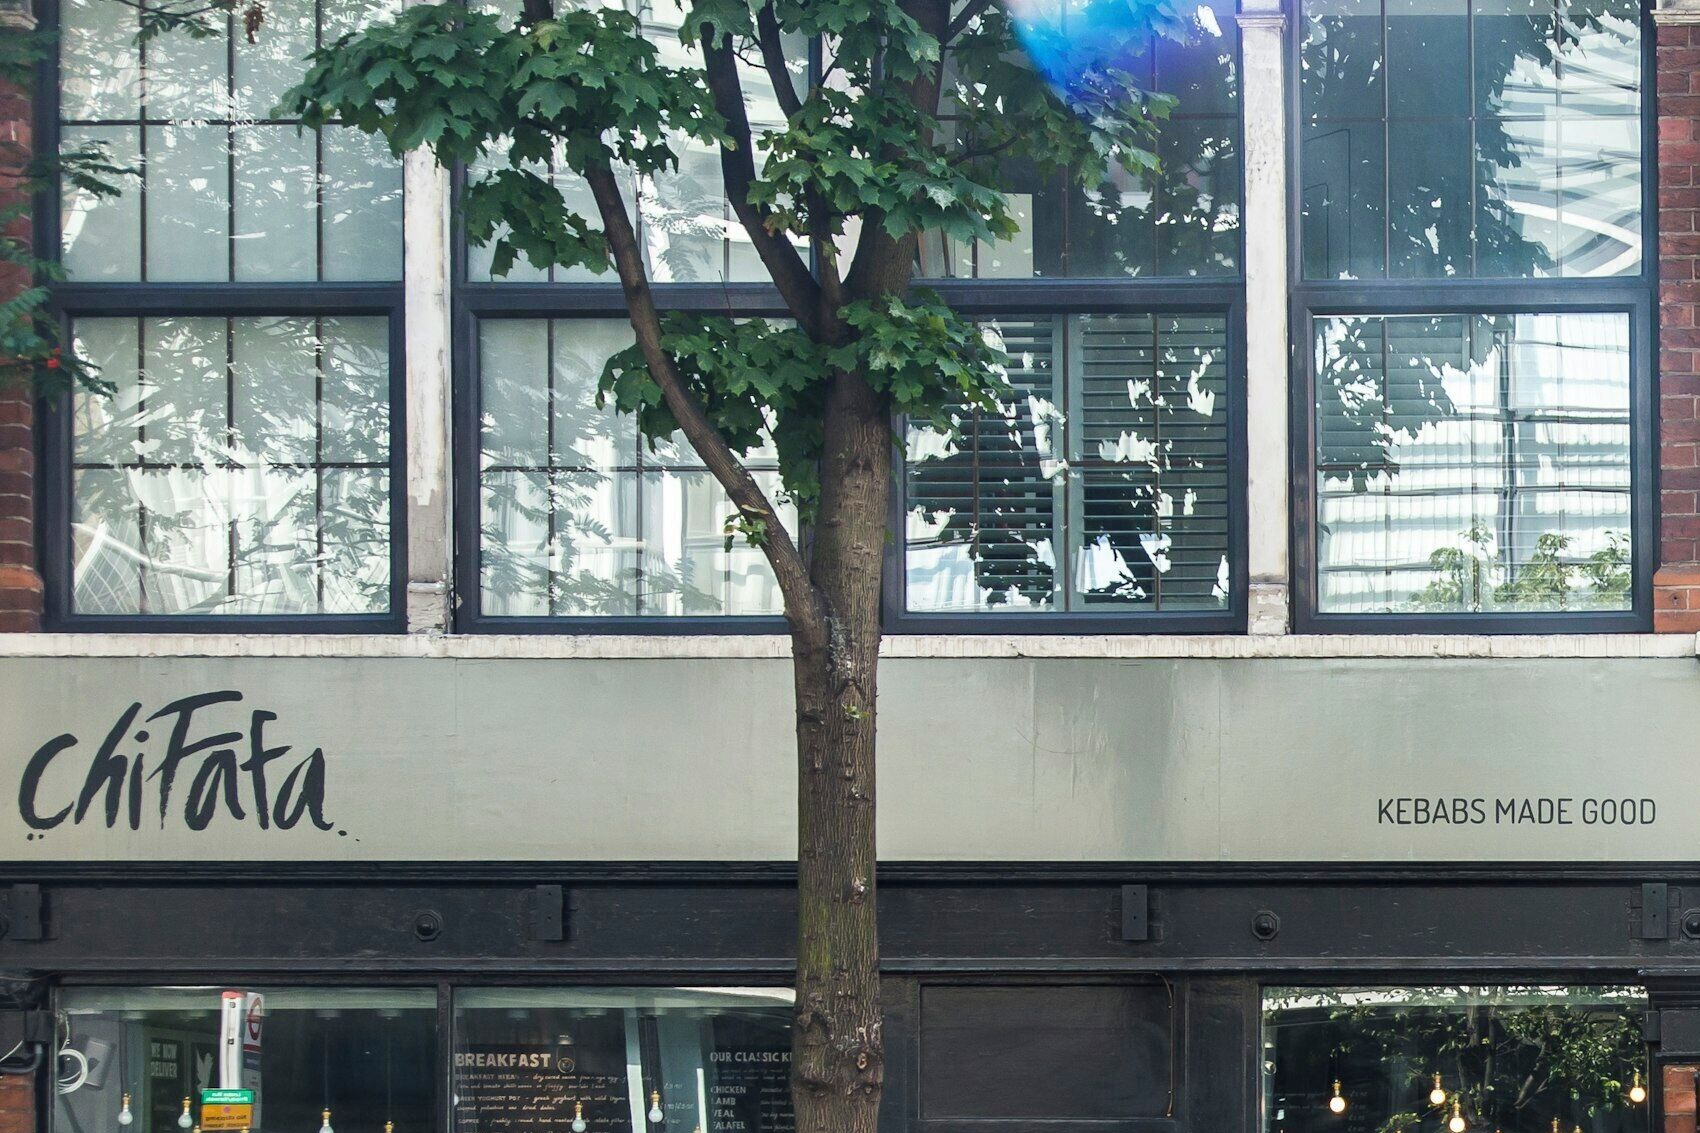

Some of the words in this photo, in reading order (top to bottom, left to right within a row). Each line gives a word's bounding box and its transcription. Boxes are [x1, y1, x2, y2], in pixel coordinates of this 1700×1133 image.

[1378, 798, 1486, 825] KEBABS
[1496, 798, 1573, 825] MADE
[1582, 798, 1657, 825] GOOD
[162, 1043, 178, 1060] NOW
[709, 1051, 732, 1062] OUR
[454, 1053, 552, 1068] BREAKFAST
[150, 1061, 178, 1078] DELIVER
[710, 1085, 747, 1094] CHICKEN
